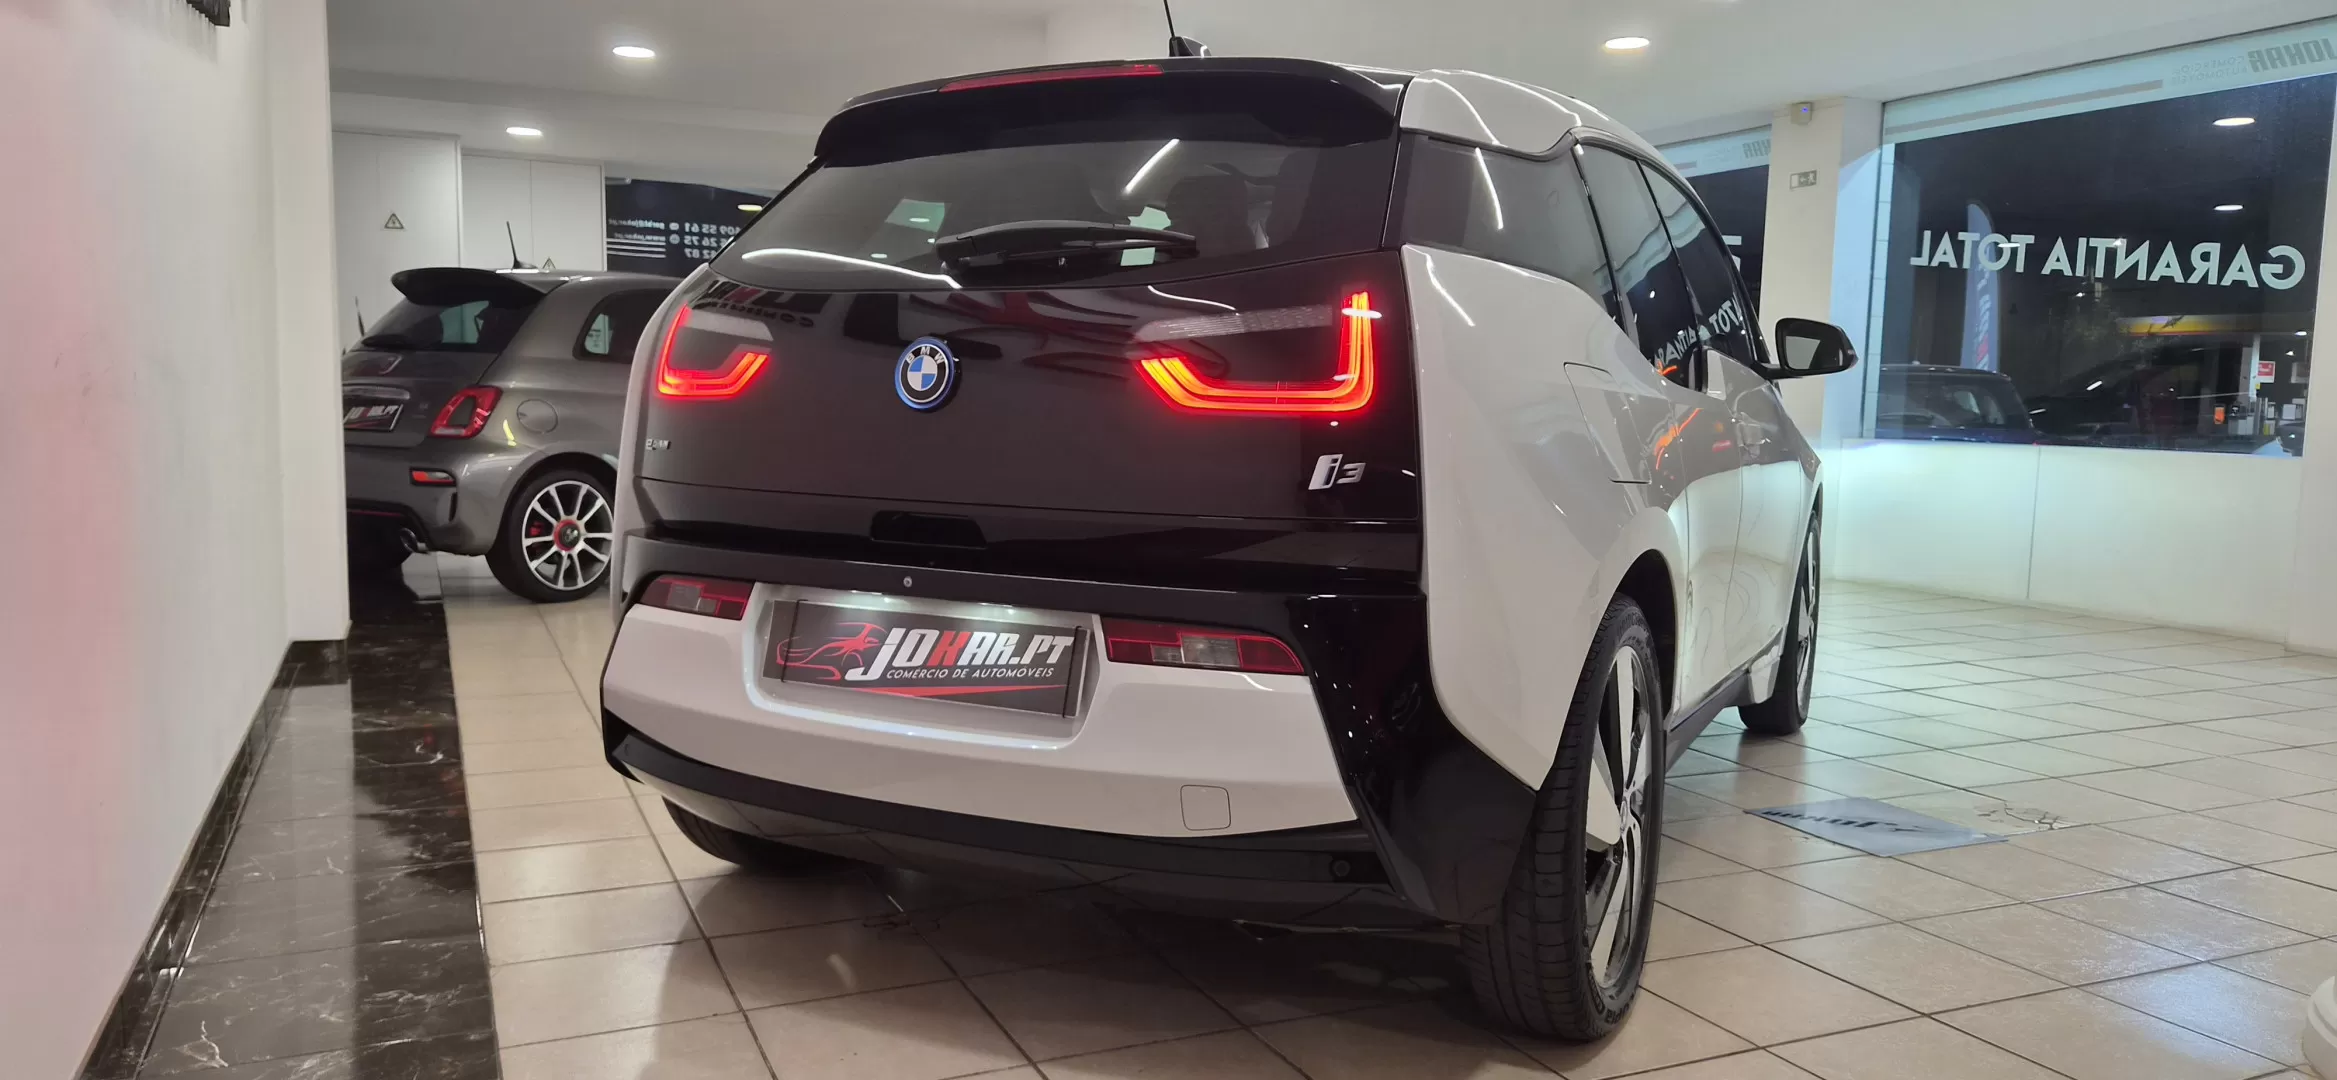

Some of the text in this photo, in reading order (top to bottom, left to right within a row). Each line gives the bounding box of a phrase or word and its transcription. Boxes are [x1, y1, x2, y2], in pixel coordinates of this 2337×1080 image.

[905, 345, 946, 365] BMW
[1308, 453, 1367, 490] i3
[952, 668, 969, 678] DE
